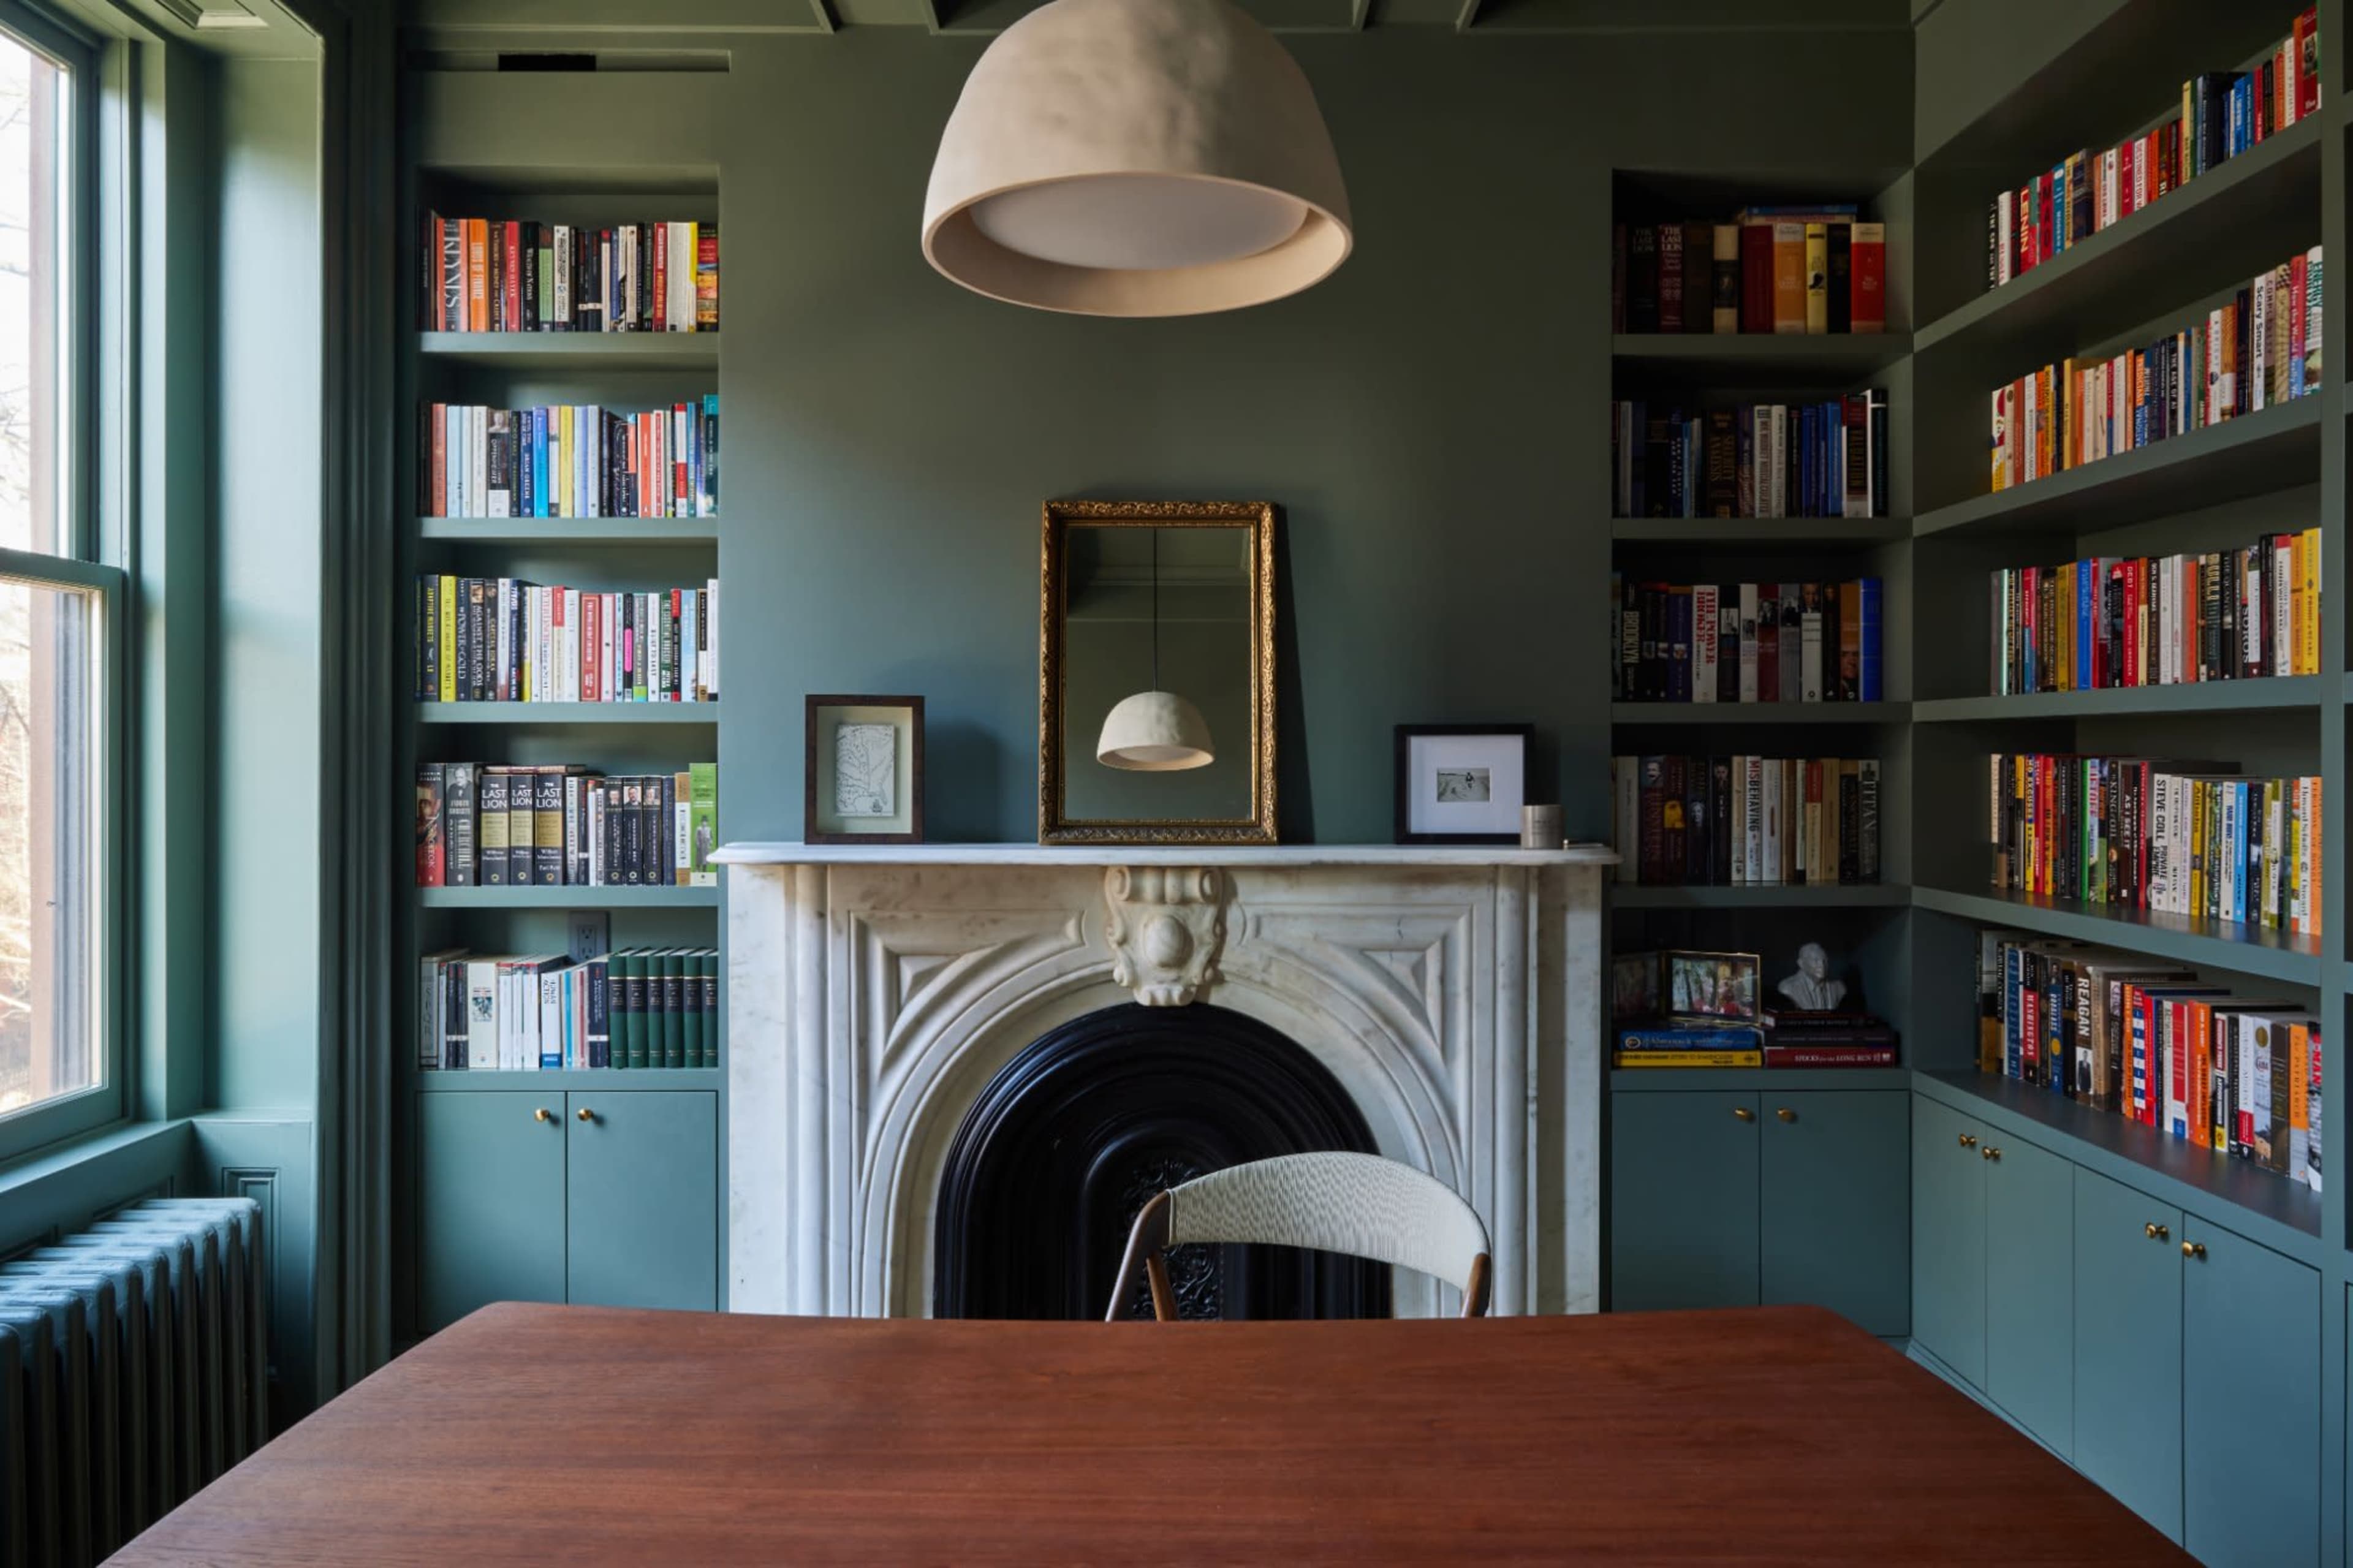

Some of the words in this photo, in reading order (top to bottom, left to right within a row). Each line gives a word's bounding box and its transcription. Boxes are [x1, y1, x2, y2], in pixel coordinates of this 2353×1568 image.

[2020, 189, 2029, 252] LENIN
[445, 237, 461, 308] KEYNES
[2256, 286, 2264, 319] Scary
[2256, 322, 2264, 358] Smart
[1696, 591, 1705, 642] BROKER
[1705, 589, 1716, 614] THE
[1623, 612, 1639, 664] BROOKLYN
[1705, 617, 1716, 665] POWER
[482, 789, 506, 798] LAST
[482, 799, 507, 809] LION
[536, 789, 562, 797] LAST
[536, 798, 562, 808] LION
[1748, 760, 1760, 832] MISBEHAVING
[1862, 781, 1877, 830] TITAN
[2124, 795, 2131, 808] AS
[2155, 780, 2166, 812] STEVE
[425, 812, 440, 868] NAPOLEON
[457, 818, 472, 869] CHURCHILL
[2124, 839, 2131, 850] IT
[2155, 816, 2166, 841] COLL
[2078, 977, 2090, 1036] REAGAN
